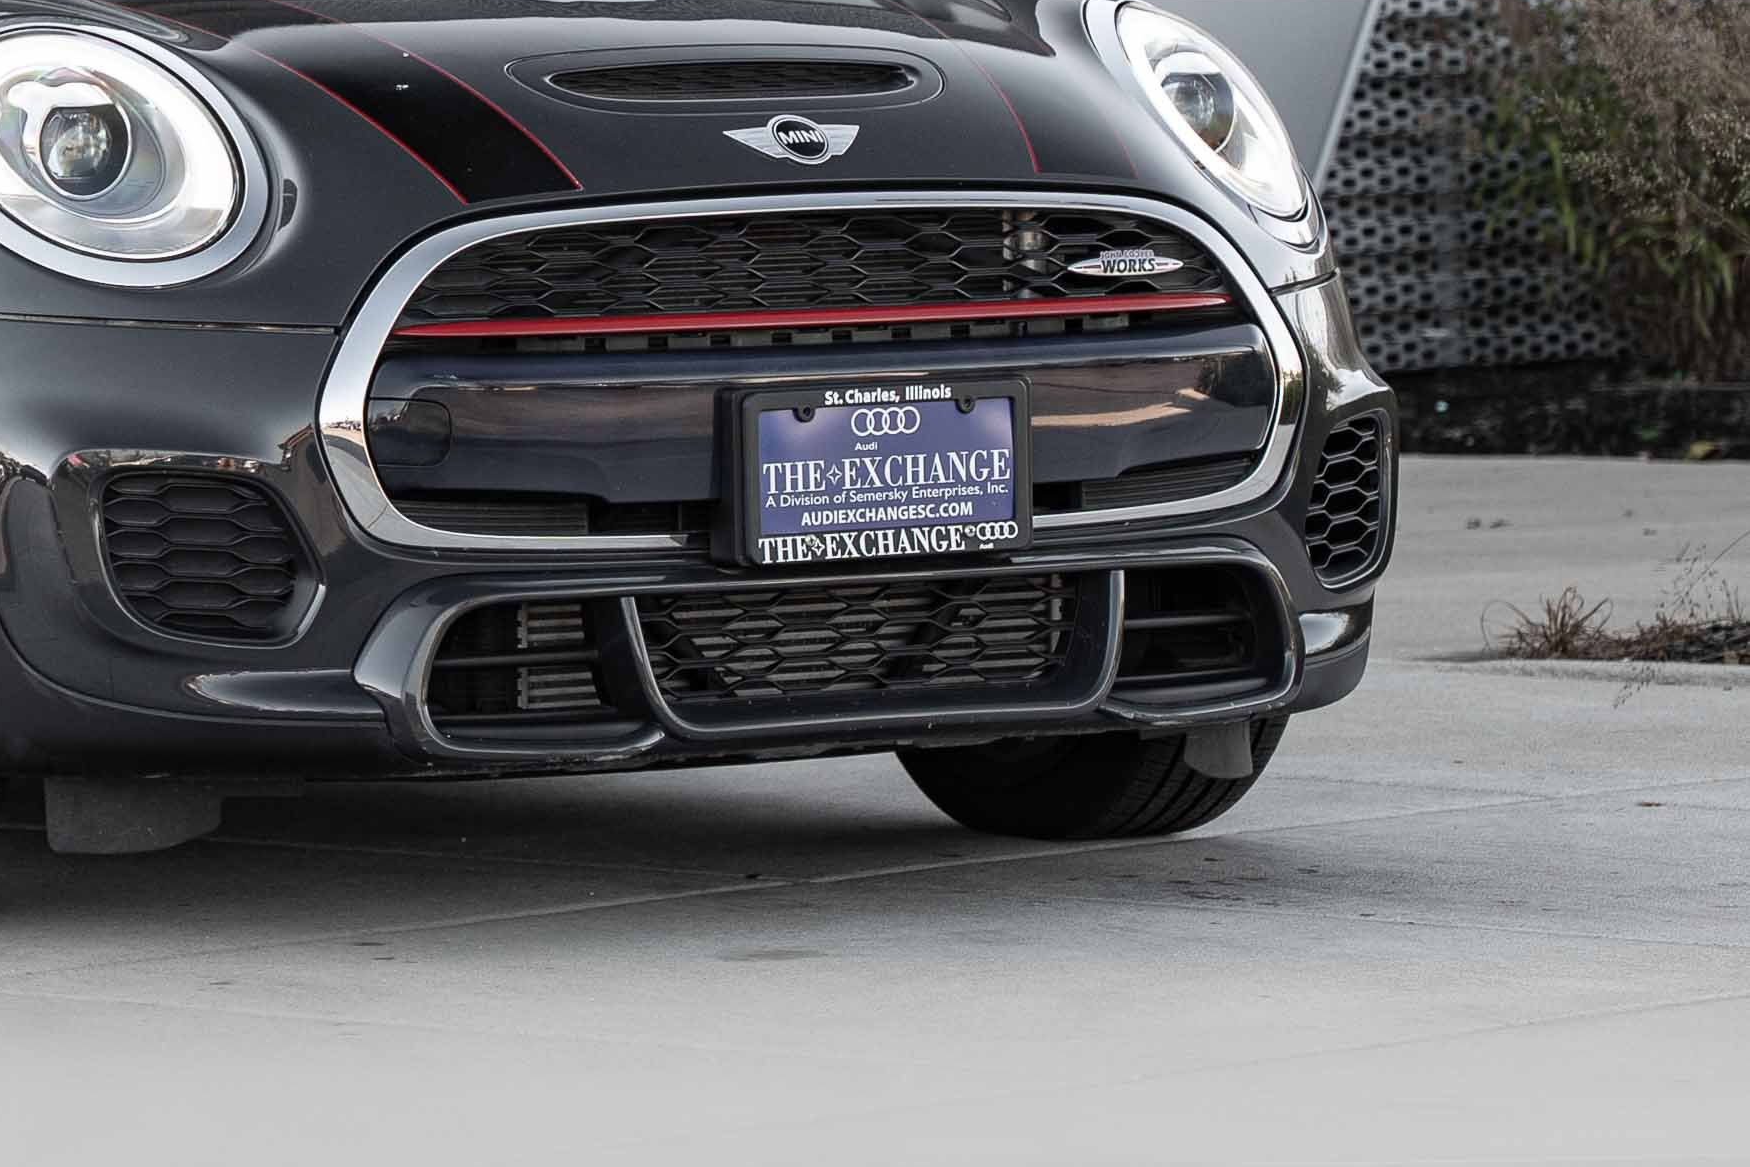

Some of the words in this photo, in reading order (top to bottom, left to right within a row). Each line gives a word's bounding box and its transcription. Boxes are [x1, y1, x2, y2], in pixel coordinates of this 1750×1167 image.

[777, 129, 824, 145] MINI
[1101, 258, 1155, 274] WORKS
[824, 390, 844, 405] St.
[845, 387, 900, 403] Charles,
[905, 384, 952, 401] Illinois
[854, 441, 878, 451] Audi
[765, 494, 777, 508] A
[780, 493, 830, 508] Division
[833, 491, 847, 504] of
[849, 488, 908, 503] Semersky
[912, 484, 984, 500] Enterprises,
[987, 481, 1009, 494] Inc.
[801, 501, 973, 526] AUDIEXCHANGESC.COM
